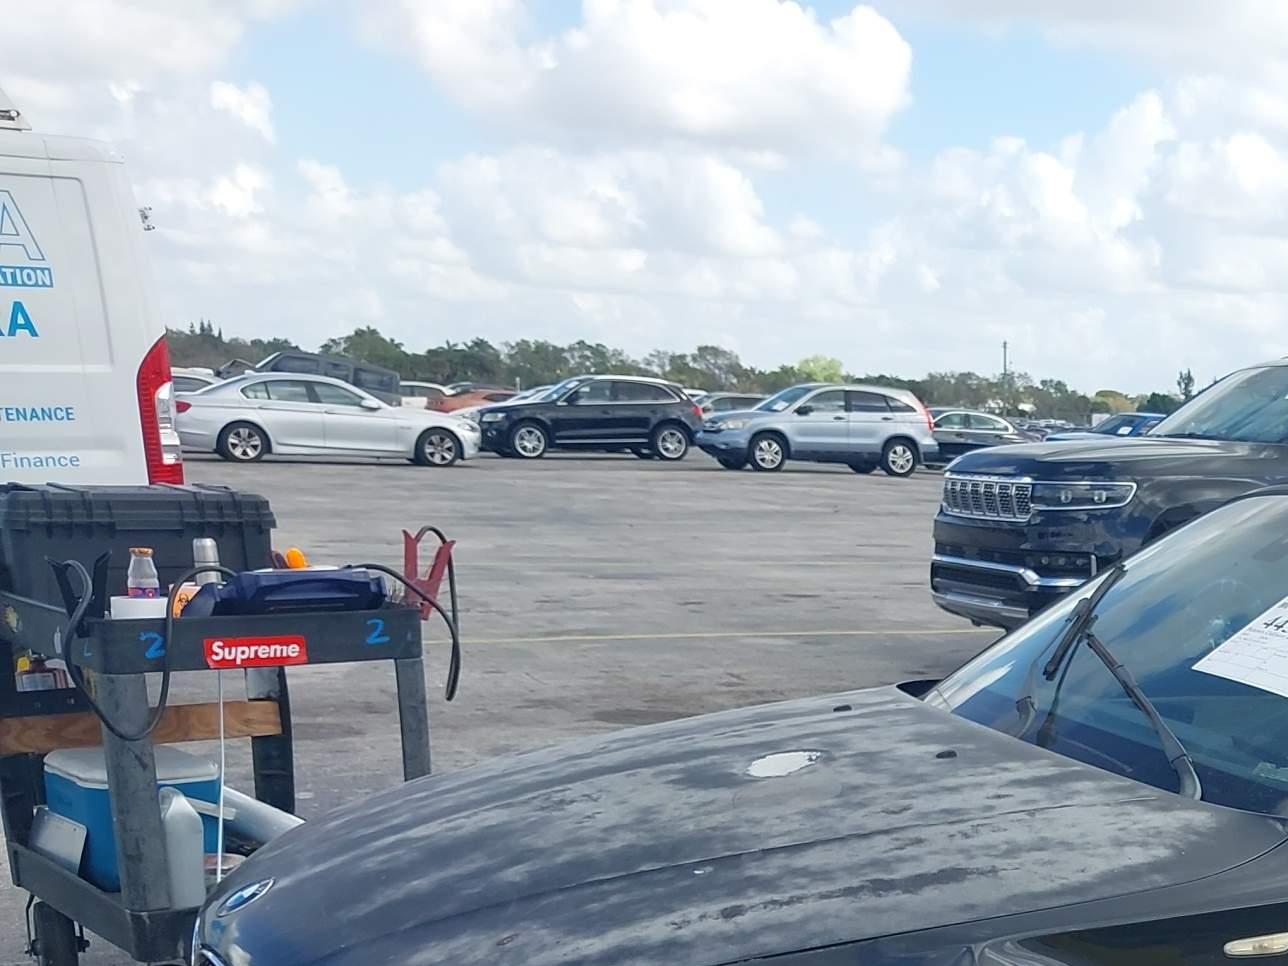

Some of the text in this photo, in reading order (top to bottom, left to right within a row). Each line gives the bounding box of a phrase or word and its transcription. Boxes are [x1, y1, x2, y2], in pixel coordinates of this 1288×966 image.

[0, 268, 50, 285] TION
[0, 452, 80, 468] Finance
[138, 618, 390, 659] 2 2
[211, 641, 300, 665] Supreme
